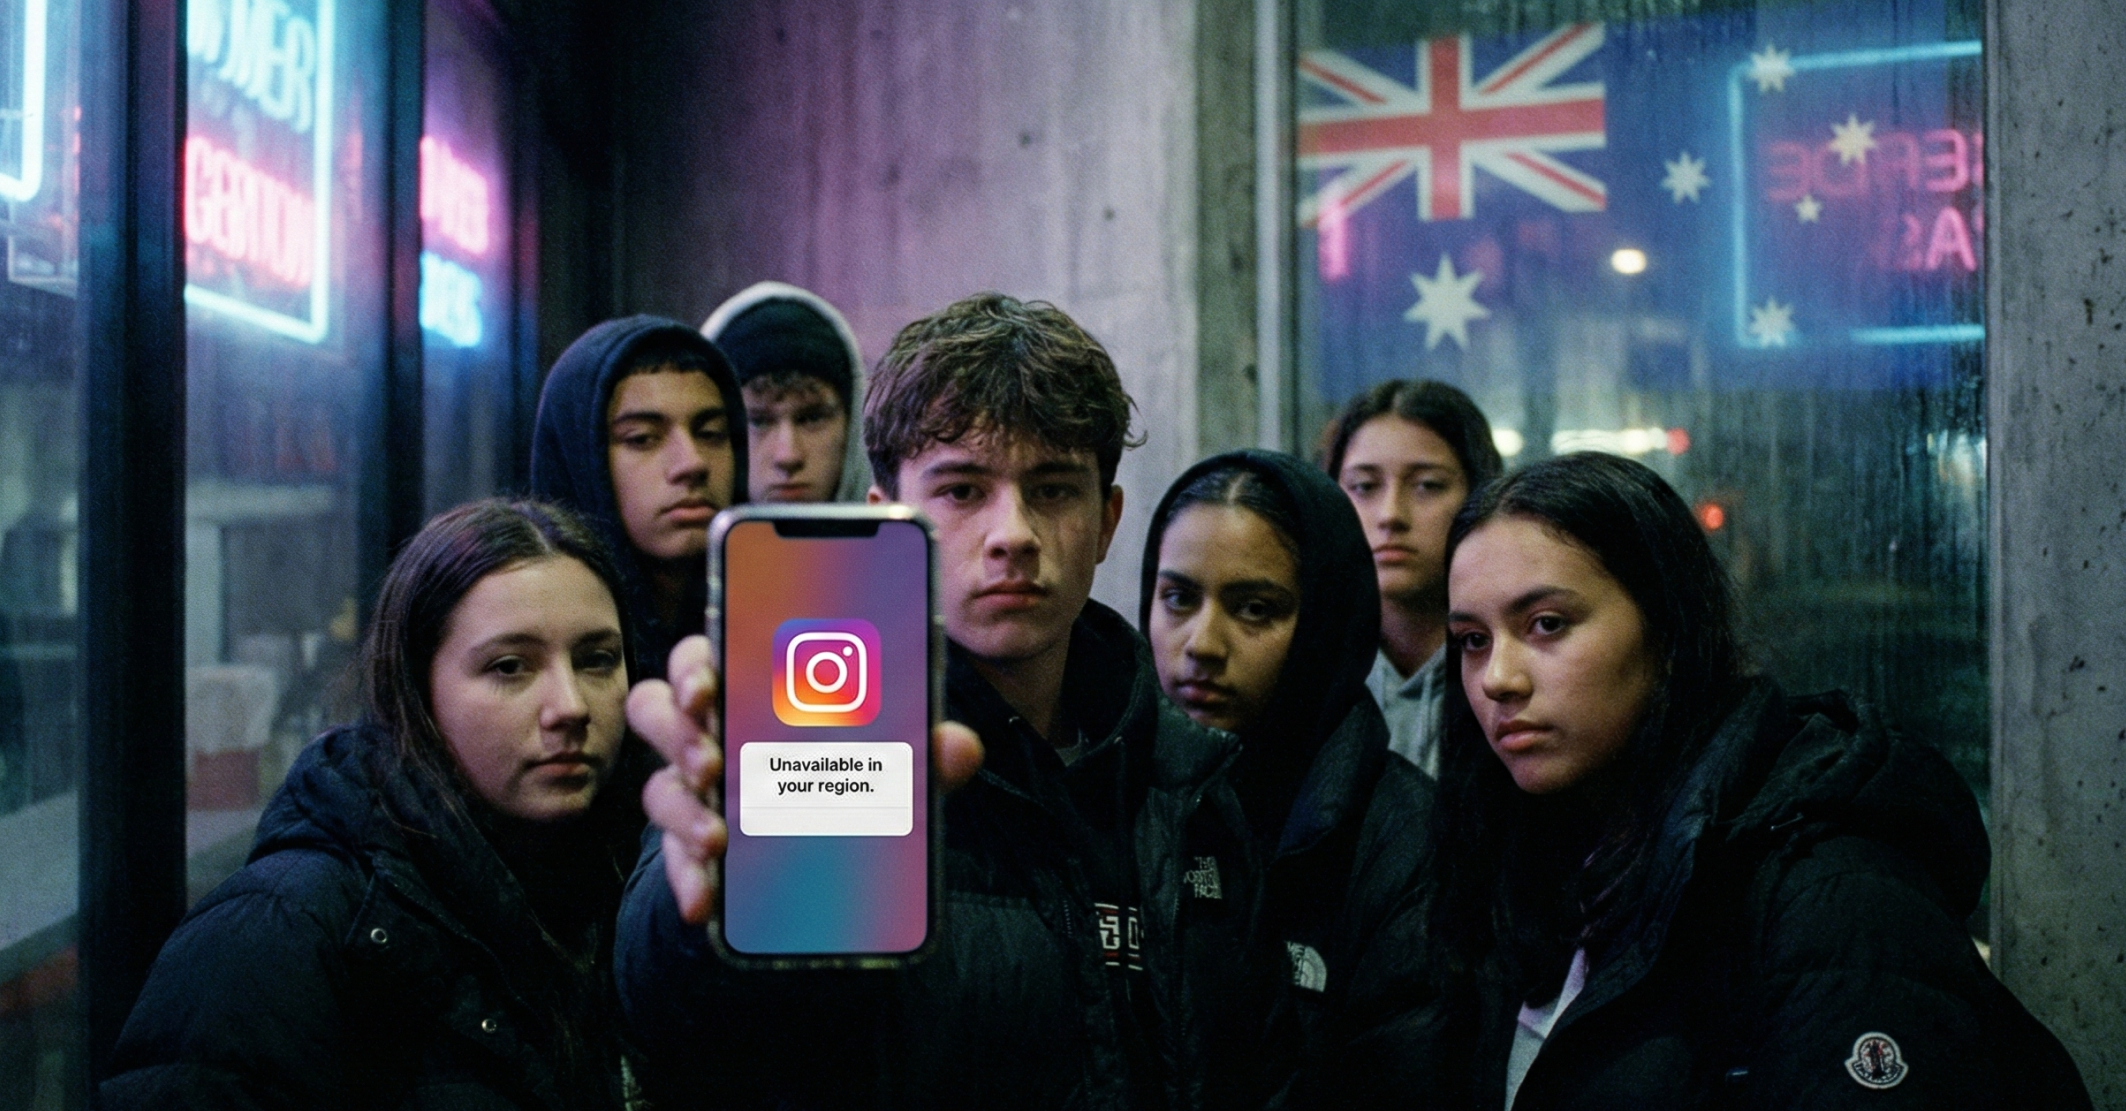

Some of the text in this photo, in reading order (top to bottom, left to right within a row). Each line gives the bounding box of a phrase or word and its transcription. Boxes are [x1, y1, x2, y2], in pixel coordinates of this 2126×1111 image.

[769, 757, 883, 772] Unavailable in
[777, 777, 875, 795] your region.
